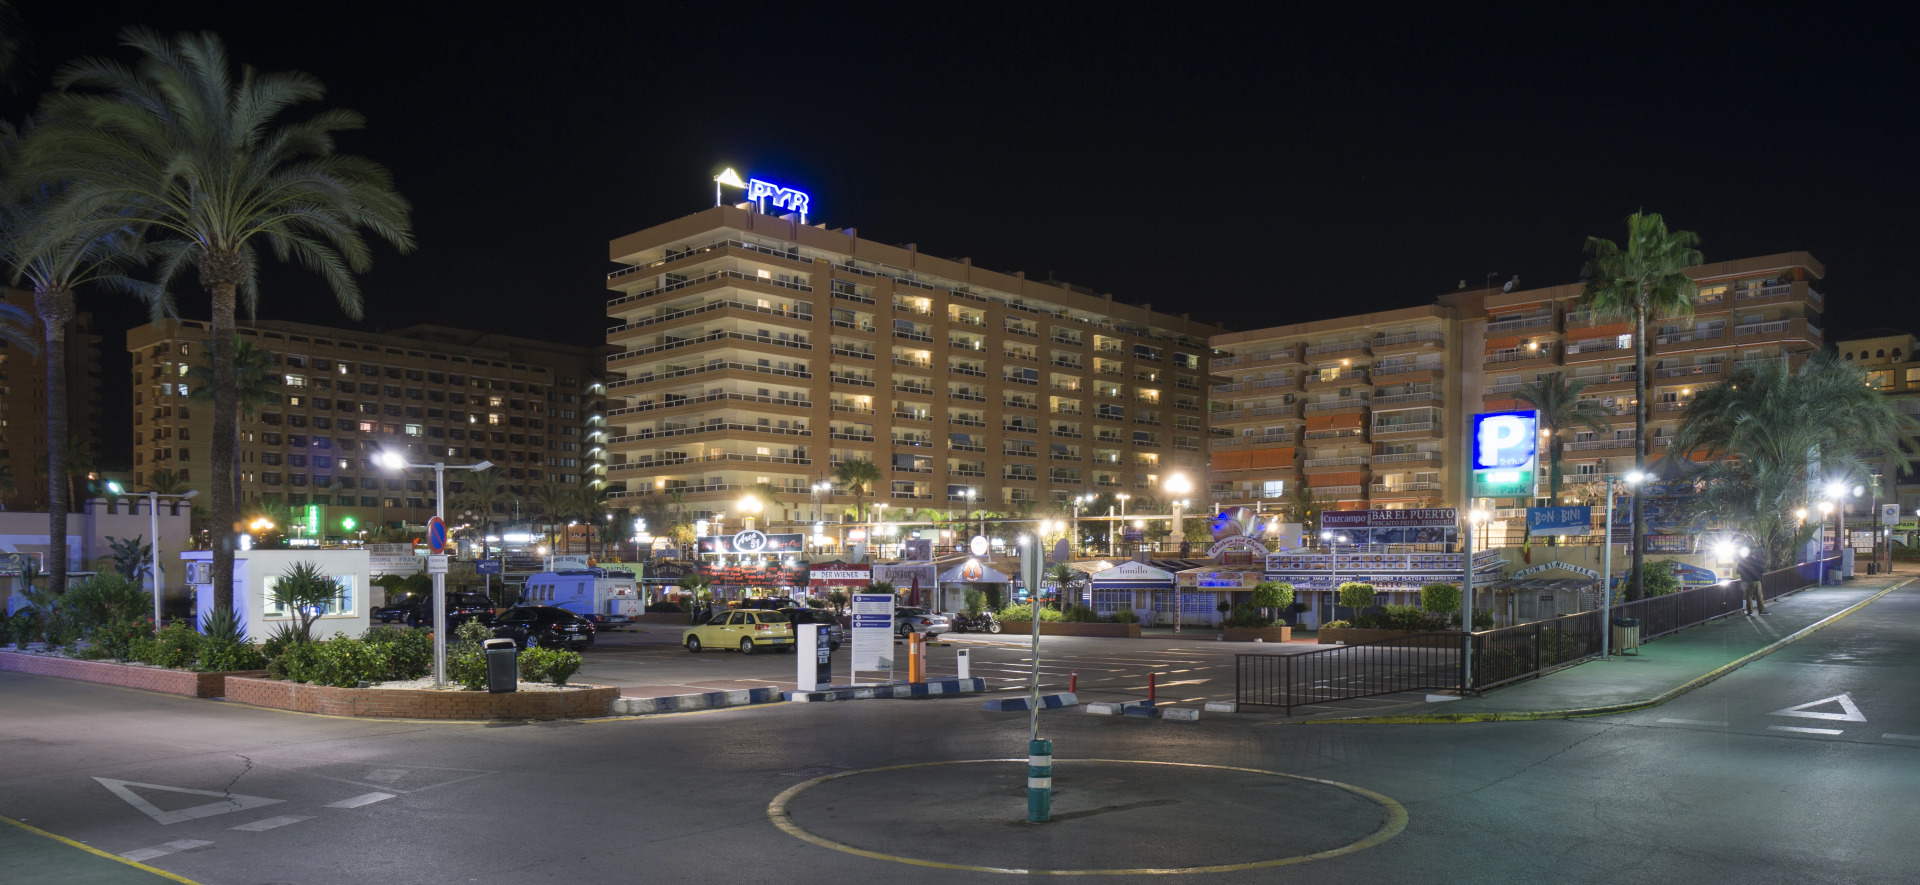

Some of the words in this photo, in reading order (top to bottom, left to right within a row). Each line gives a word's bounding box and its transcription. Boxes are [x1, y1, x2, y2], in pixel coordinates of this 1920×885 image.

[748, 178, 809, 214] PYR
[1481, 415, 1526, 466] P
[1323, 515, 1366, 523] Cruzcampo
[1371, 511, 1393, 520] BAR
[1394, 511, 1408, 520] EL
[1410, 509, 1455, 519] PUERTO
[1561, 508, 1580, 523] BINI
[737, 532, 757, 545] Area
[1212, 539, 1233, 553] Chicken
[1246, 540, 1263, 553] Chips
[652, 566, 667, 576] EASY
[669, 566, 684, 576] DAYS
[1117, 566, 1148, 574] Tomillo
[1523, 567, 1540, 576] BON
